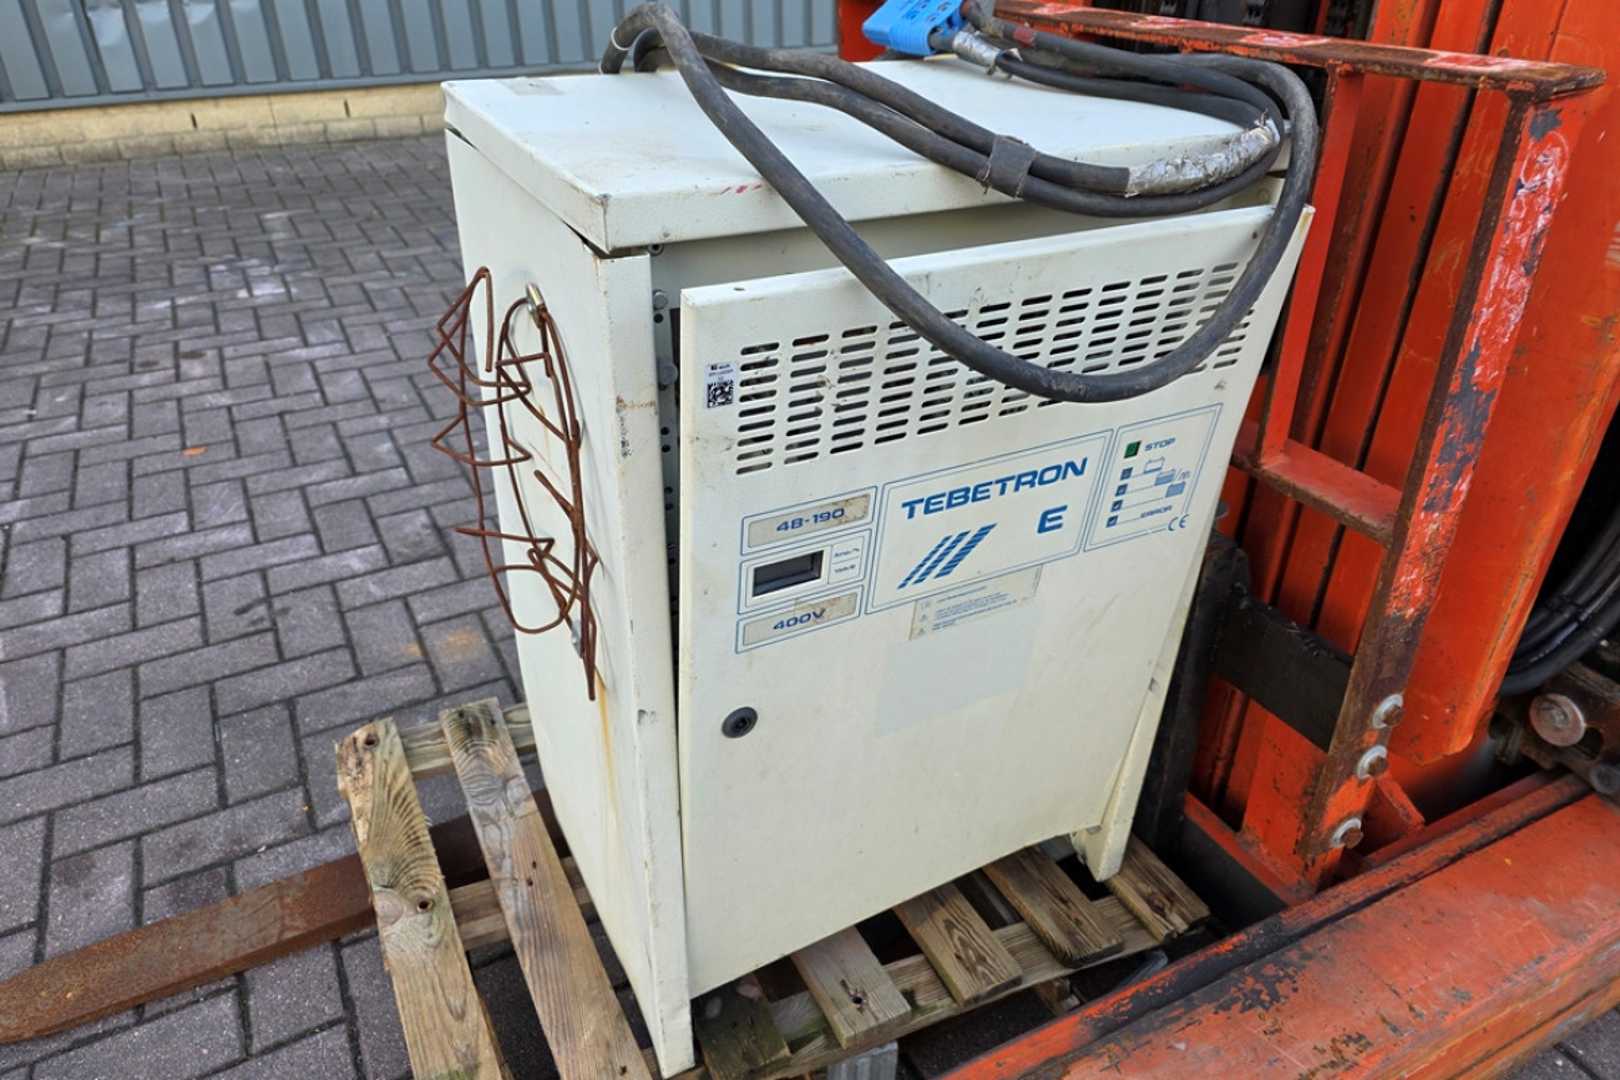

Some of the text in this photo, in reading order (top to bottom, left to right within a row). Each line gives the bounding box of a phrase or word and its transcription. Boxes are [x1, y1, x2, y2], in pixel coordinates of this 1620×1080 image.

[1144, 437, 1176, 452] STOP
[901, 456, 1089, 520] TEBETRON
[1037, 505, 1068, 534] E
[773, 608, 827, 630] 400V
